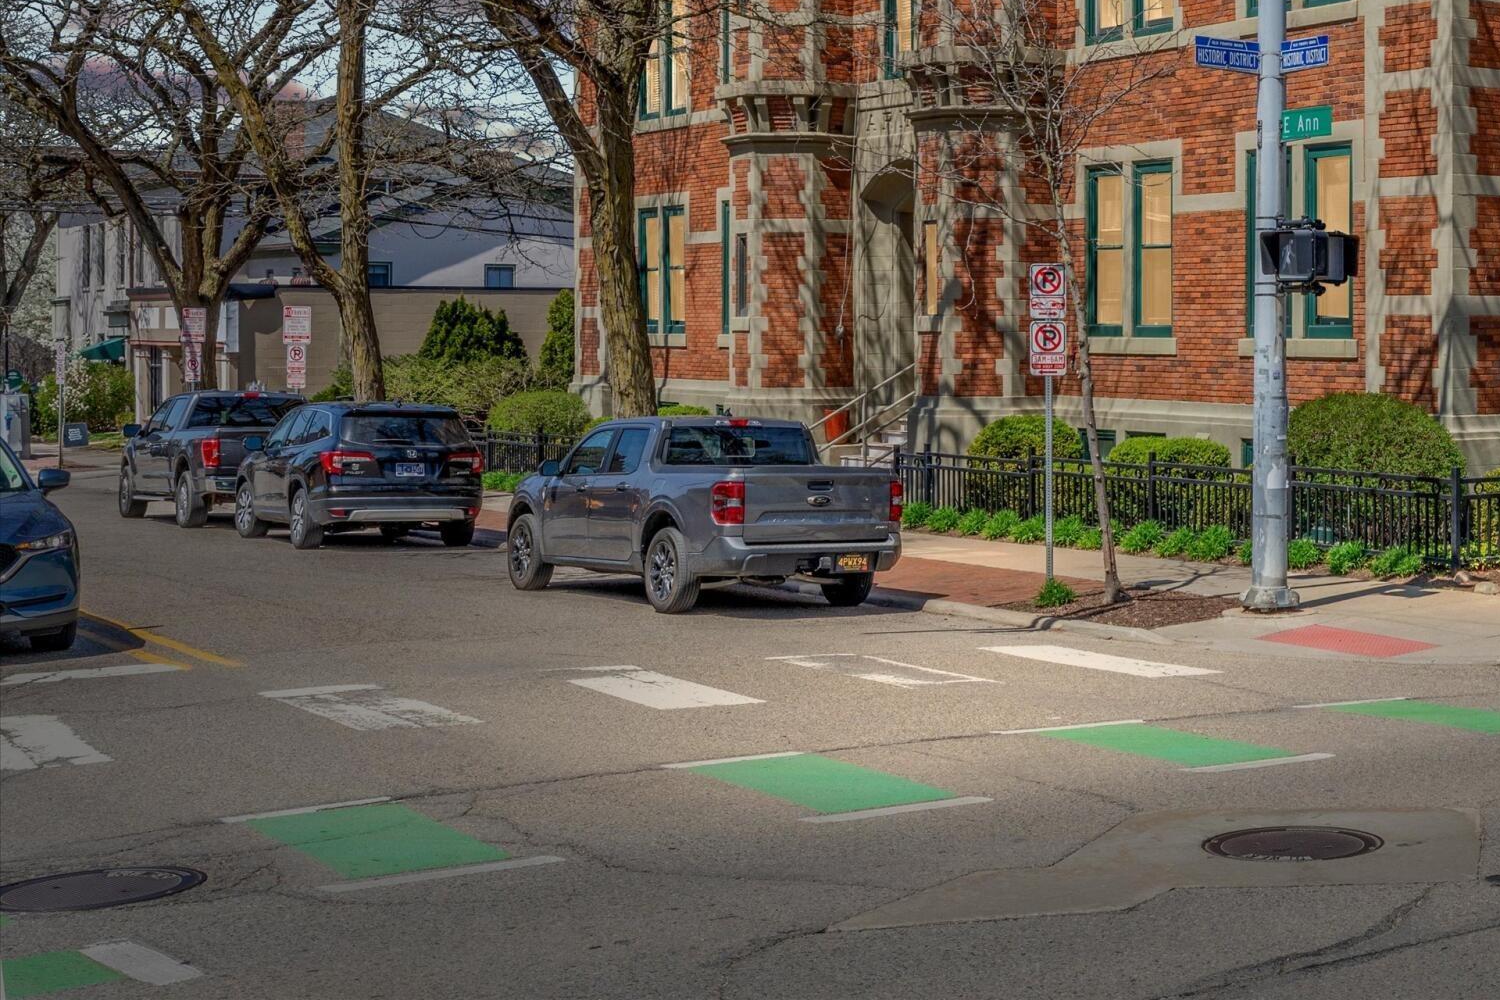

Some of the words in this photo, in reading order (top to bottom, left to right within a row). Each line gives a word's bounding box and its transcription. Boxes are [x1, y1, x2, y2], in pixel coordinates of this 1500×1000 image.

[1198, 47, 1228, 65] HISTORIC
[1229, 51, 1257, 68] DISTRICT
[1282, 50, 1304, 67] HISTORIC
[1305, 47, 1327, 64] DISTRICT
[1283, 116, 1290, 134] E
[1297, 114, 1319, 132] Ann
